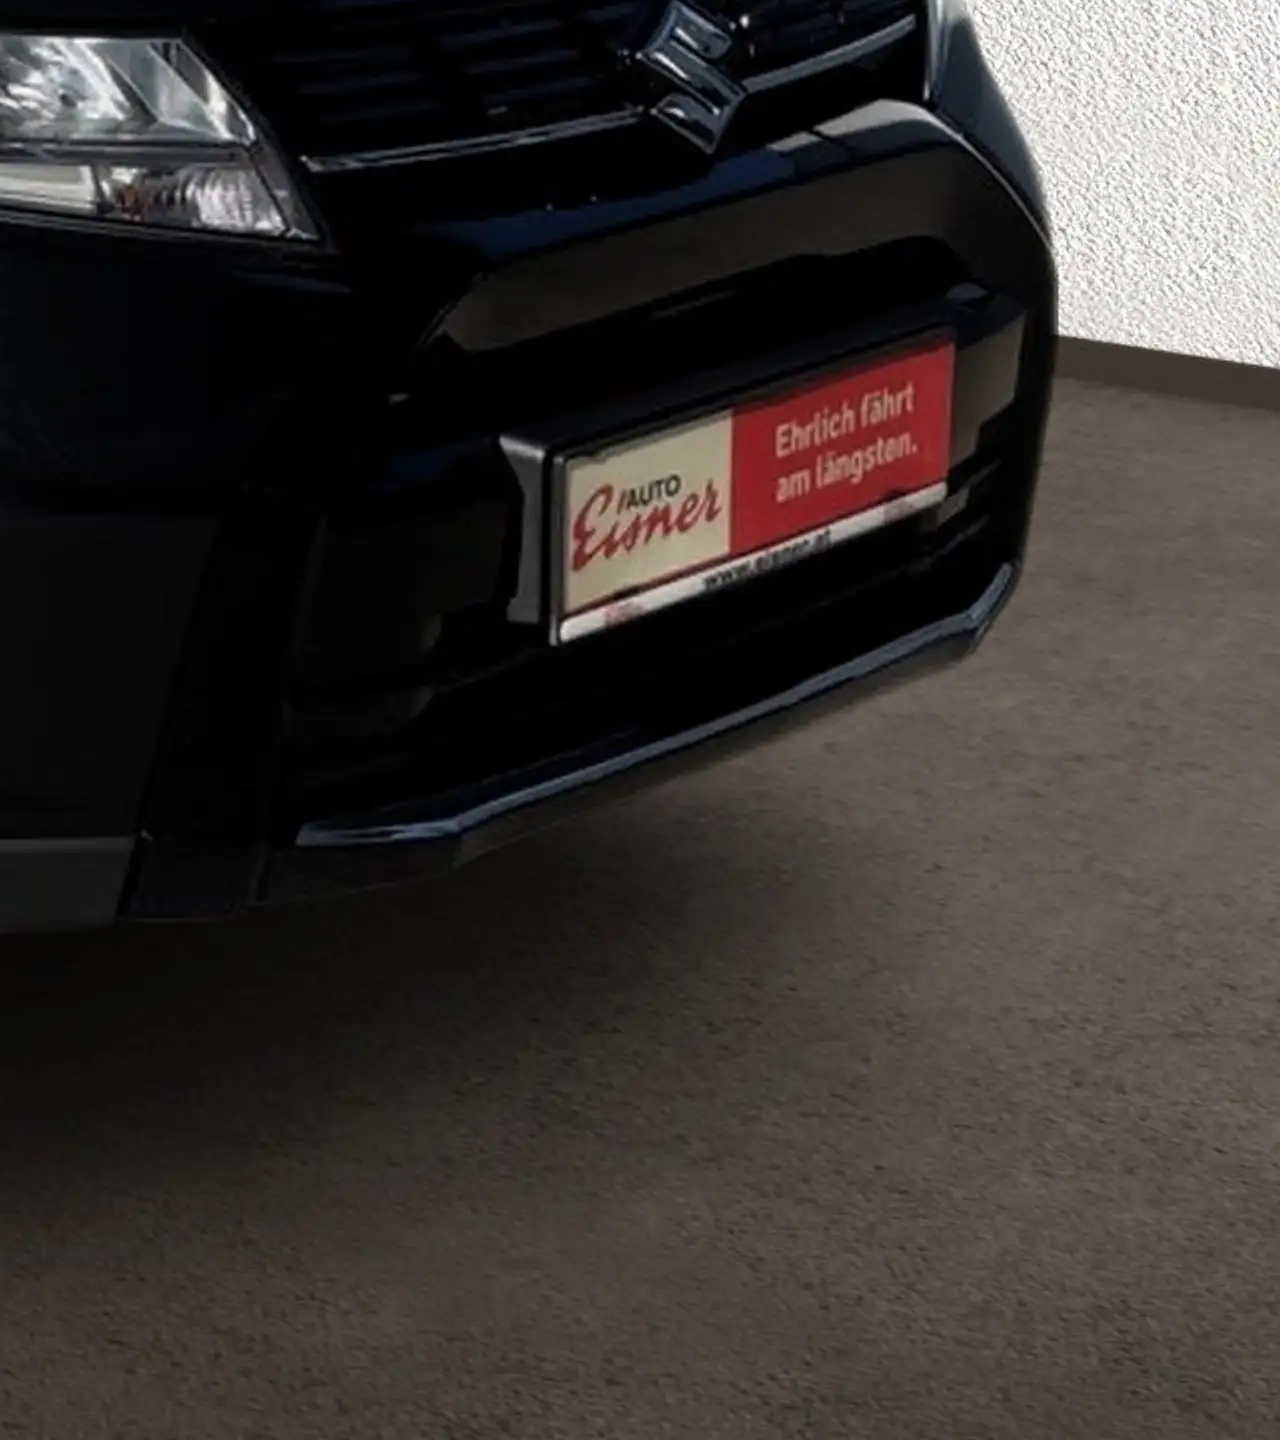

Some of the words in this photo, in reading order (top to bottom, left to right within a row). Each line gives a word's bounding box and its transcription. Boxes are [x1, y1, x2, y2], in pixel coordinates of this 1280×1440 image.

[776, 401, 856, 458] Ehrlich
[860, 383, 914, 428] fährt
[627, 474, 682, 510] AUTO
[776, 469, 810, 503] am
[815, 432, 918, 488] längsten.
[572, 477, 724, 572] Eisner
